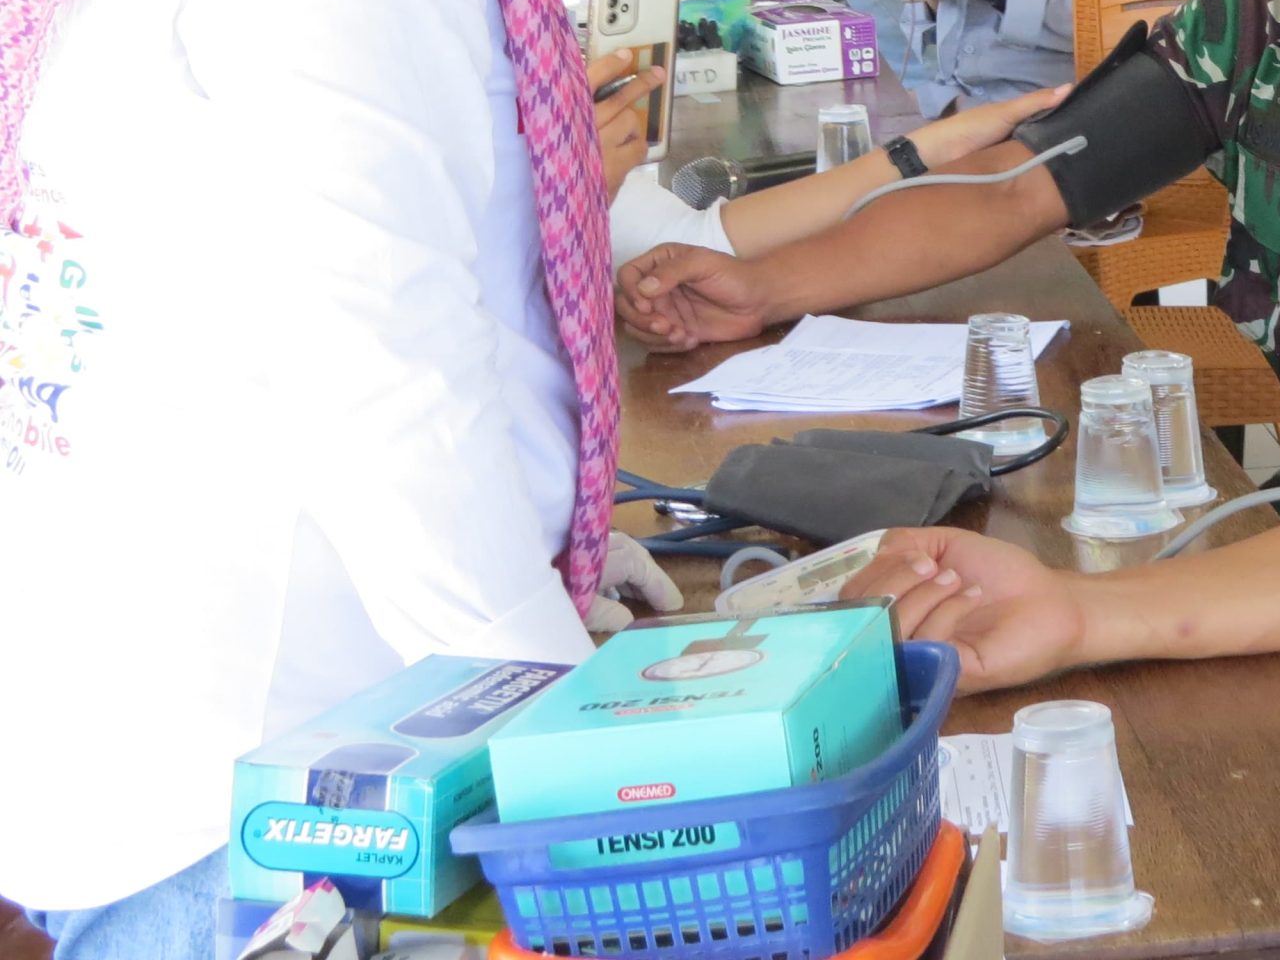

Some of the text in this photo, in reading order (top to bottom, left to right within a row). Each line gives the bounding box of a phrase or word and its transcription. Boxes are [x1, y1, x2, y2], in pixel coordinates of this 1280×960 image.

[781, 25, 832, 41] JASMINE
[466, 668, 557, 713] FARGETIX
[577, 699, 643, 713] 200
[620, 784, 673, 801] ONEMED
[262, 817, 409, 852] FARGETIX
[596, 823, 716, 855] TENSI 200
[355, 851, 404, 866] KAPLET
